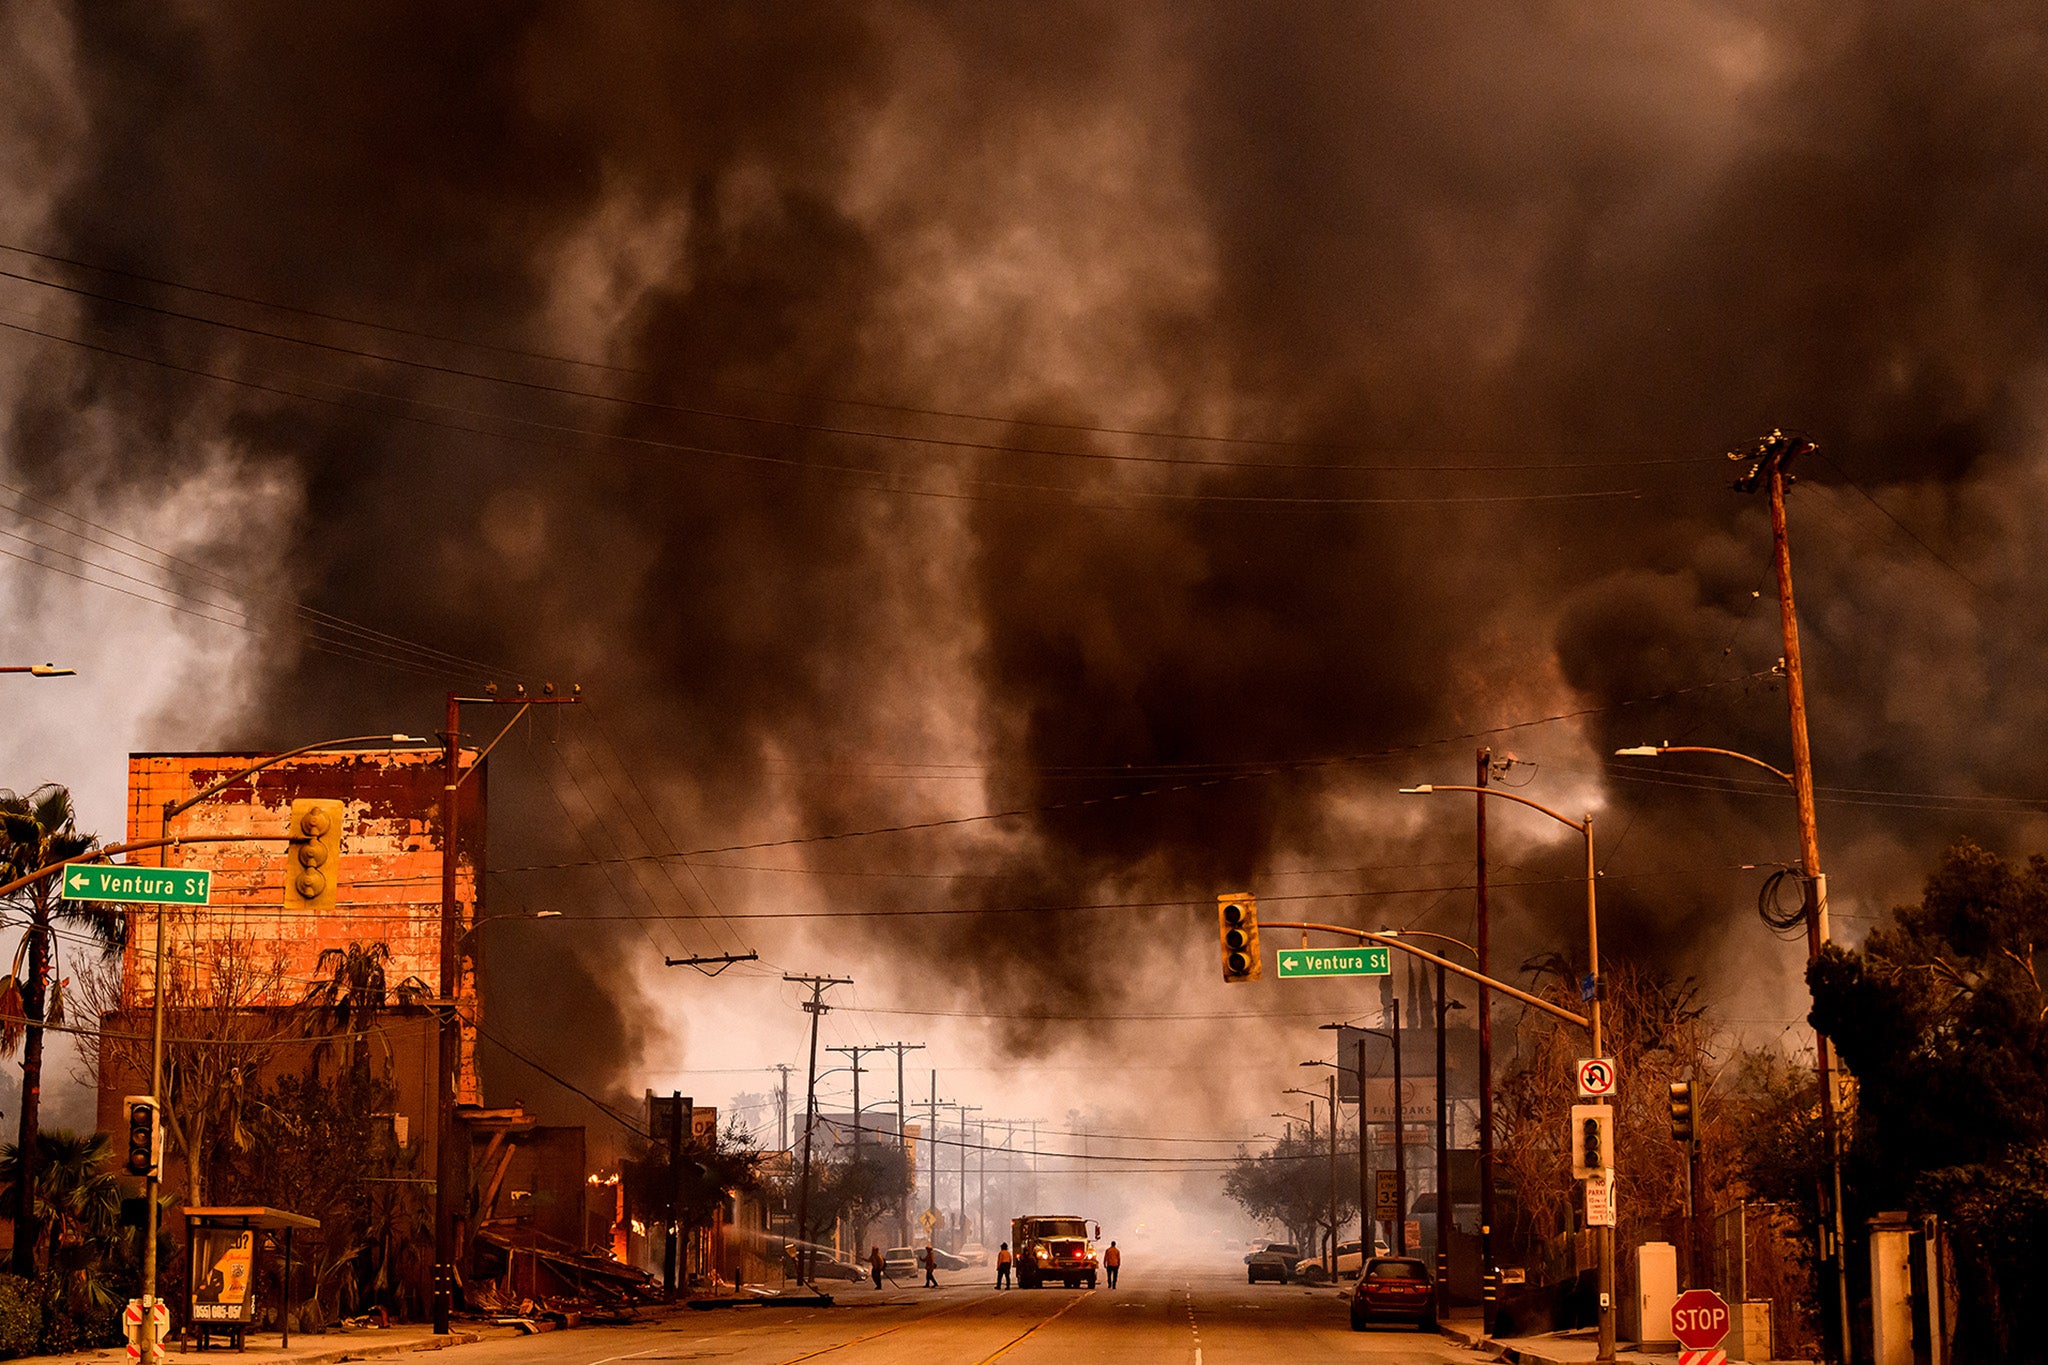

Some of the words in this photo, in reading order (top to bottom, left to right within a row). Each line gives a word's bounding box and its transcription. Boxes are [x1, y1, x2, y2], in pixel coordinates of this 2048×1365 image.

[100, 874, 174, 895] Ventura
[184, 878, 206, 896] St
[1305, 955, 1363, 970] Ventura
[1370, 953, 1386, 968] St
[1401, 1106, 1432, 1114] OAKS
[1675, 1308, 1725, 1331] STOP
